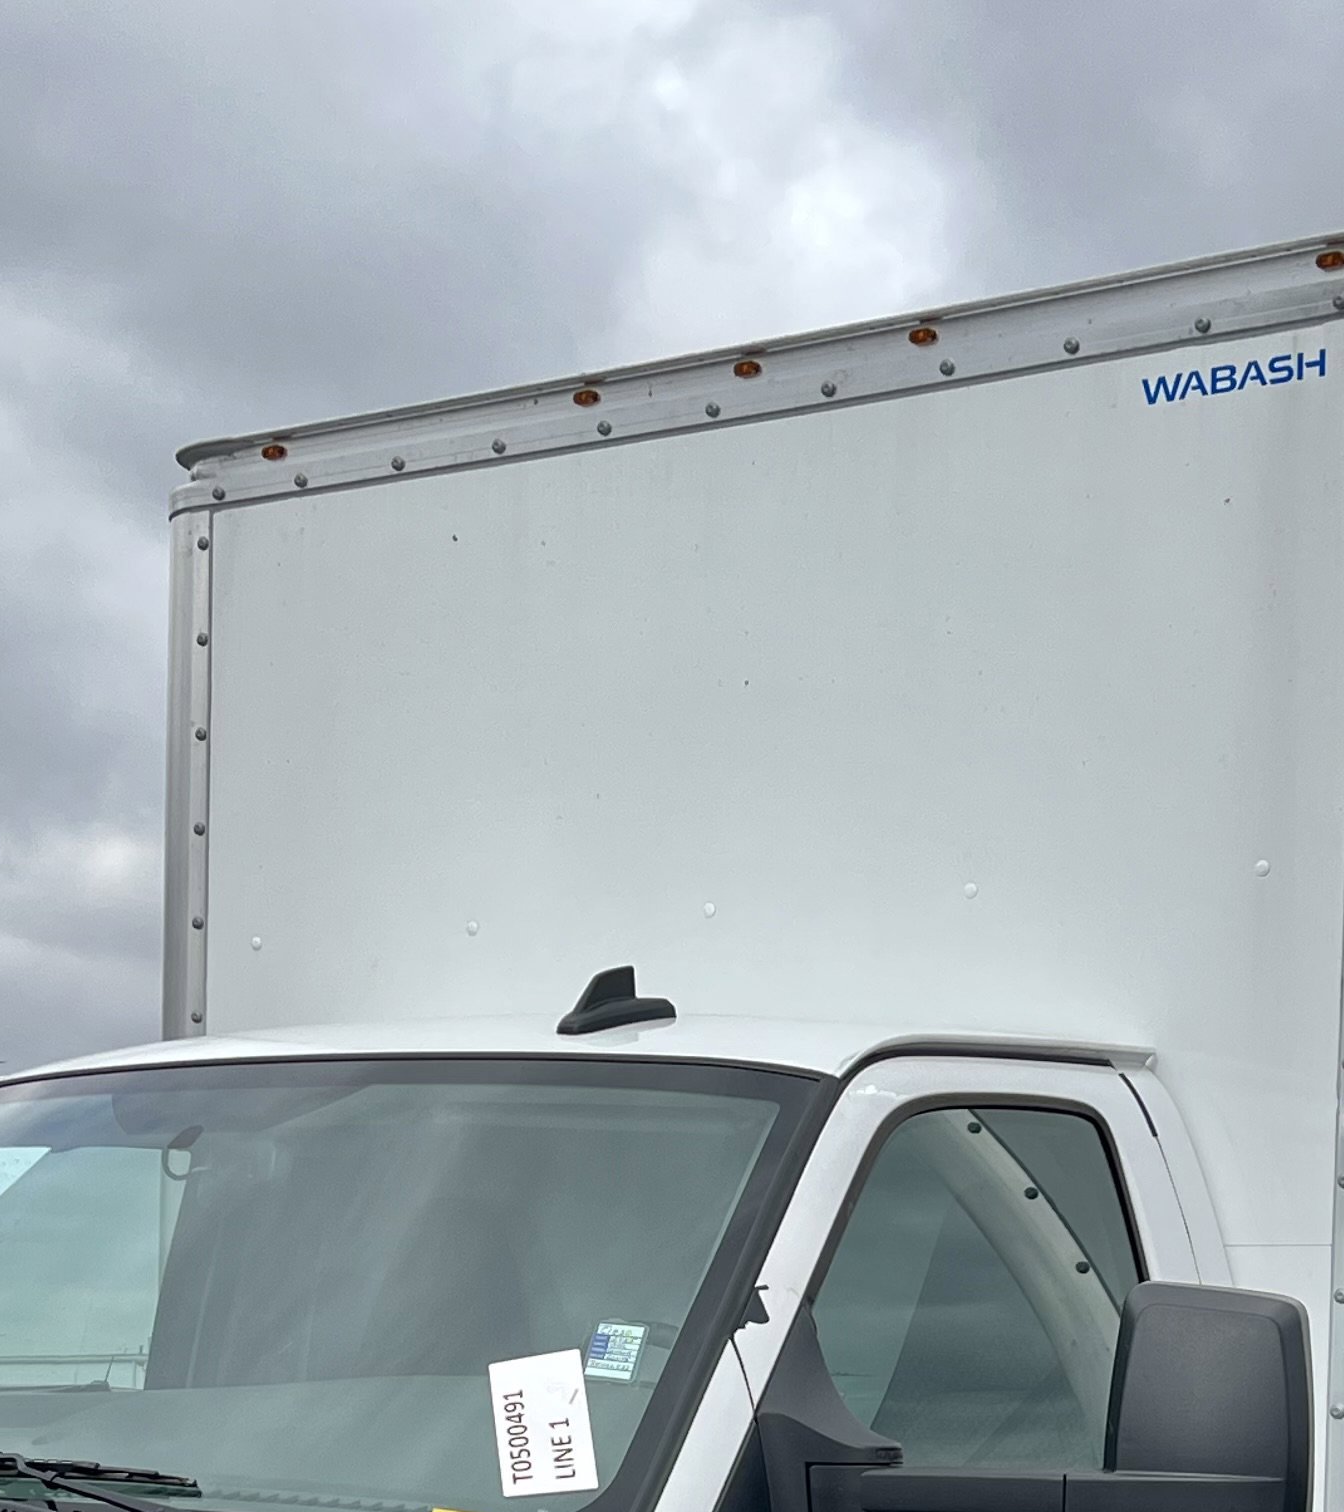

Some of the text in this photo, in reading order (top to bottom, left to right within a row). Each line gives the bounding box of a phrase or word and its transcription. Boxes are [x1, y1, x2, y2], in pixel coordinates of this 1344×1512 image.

[1141, 348, 1327, 406] WABASH
[502, 1389, 534, 1485] T0500491
[549, 1417, 576, 1480] LINE 1
